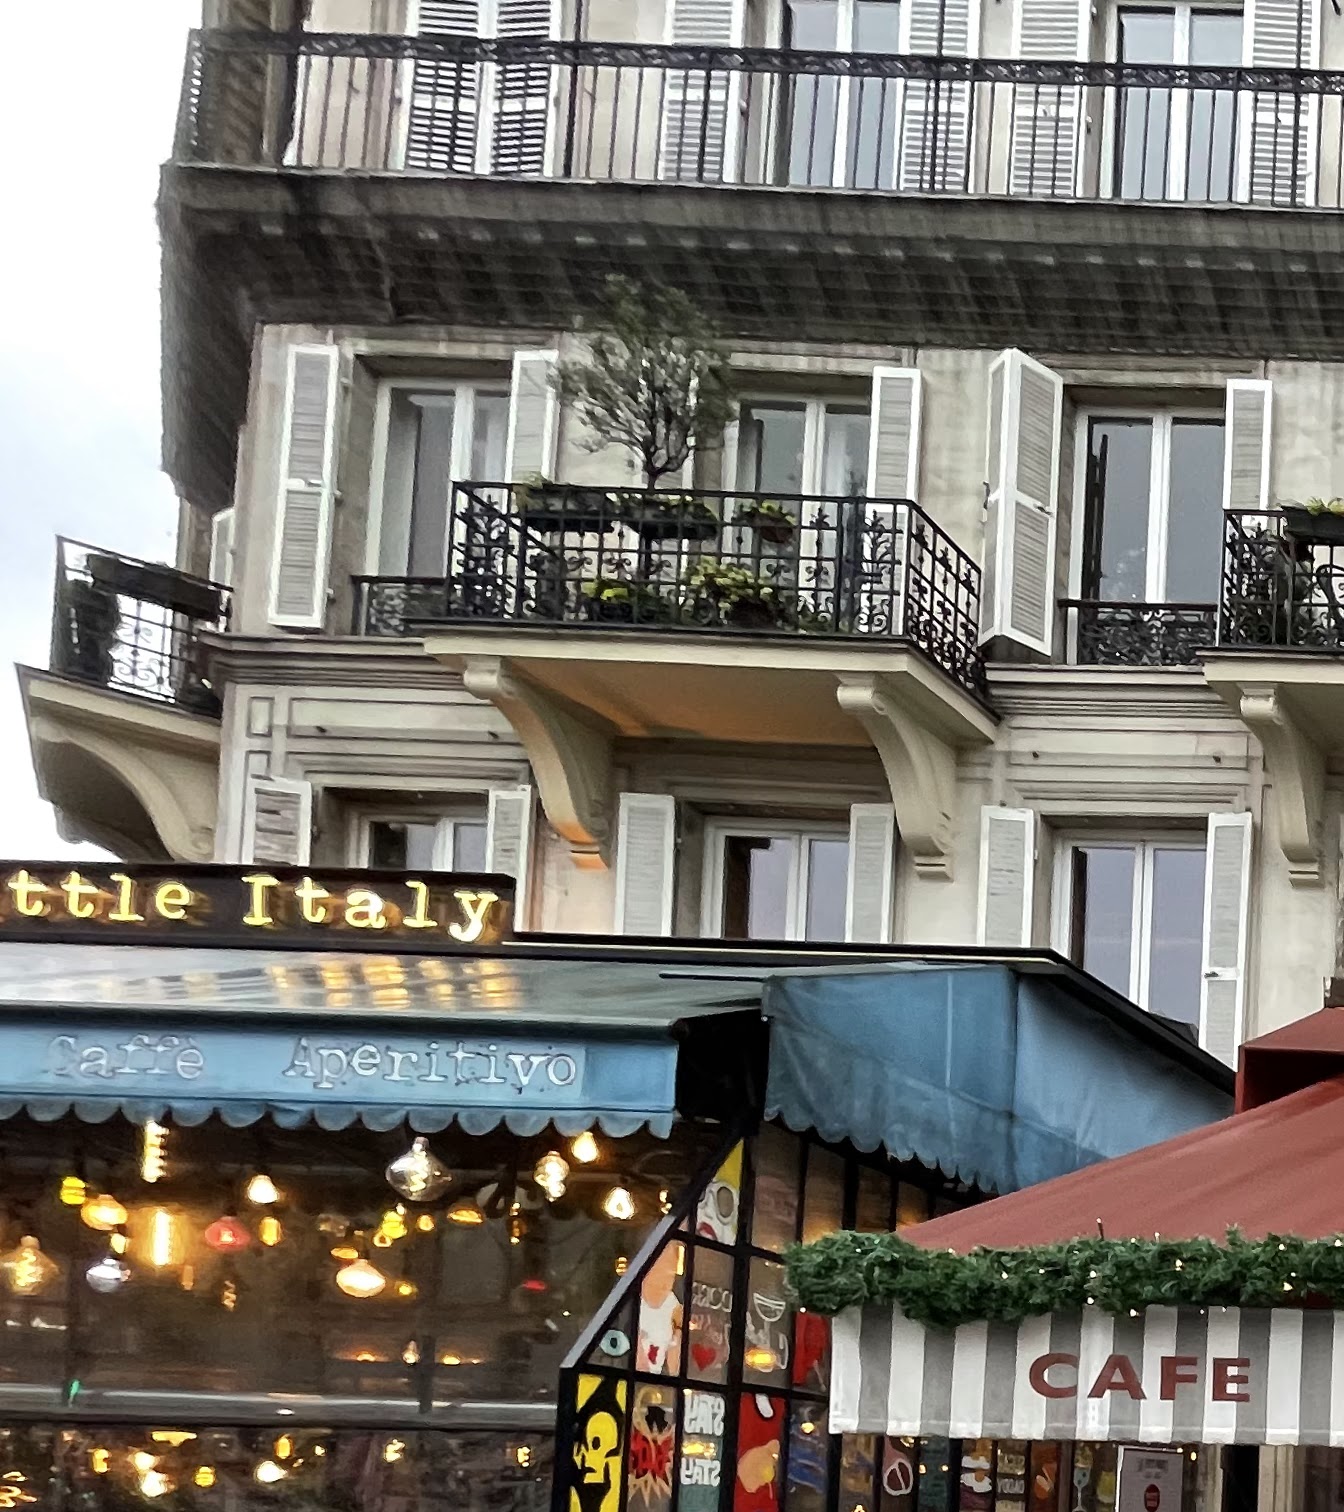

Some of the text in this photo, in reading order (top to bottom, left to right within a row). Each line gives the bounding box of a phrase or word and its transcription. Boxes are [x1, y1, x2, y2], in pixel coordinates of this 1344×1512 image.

[241, 875, 499, 943] Italy
[282, 1036, 577, 1089] Aperitivo
[1028, 1352, 1251, 1403] CAFE
